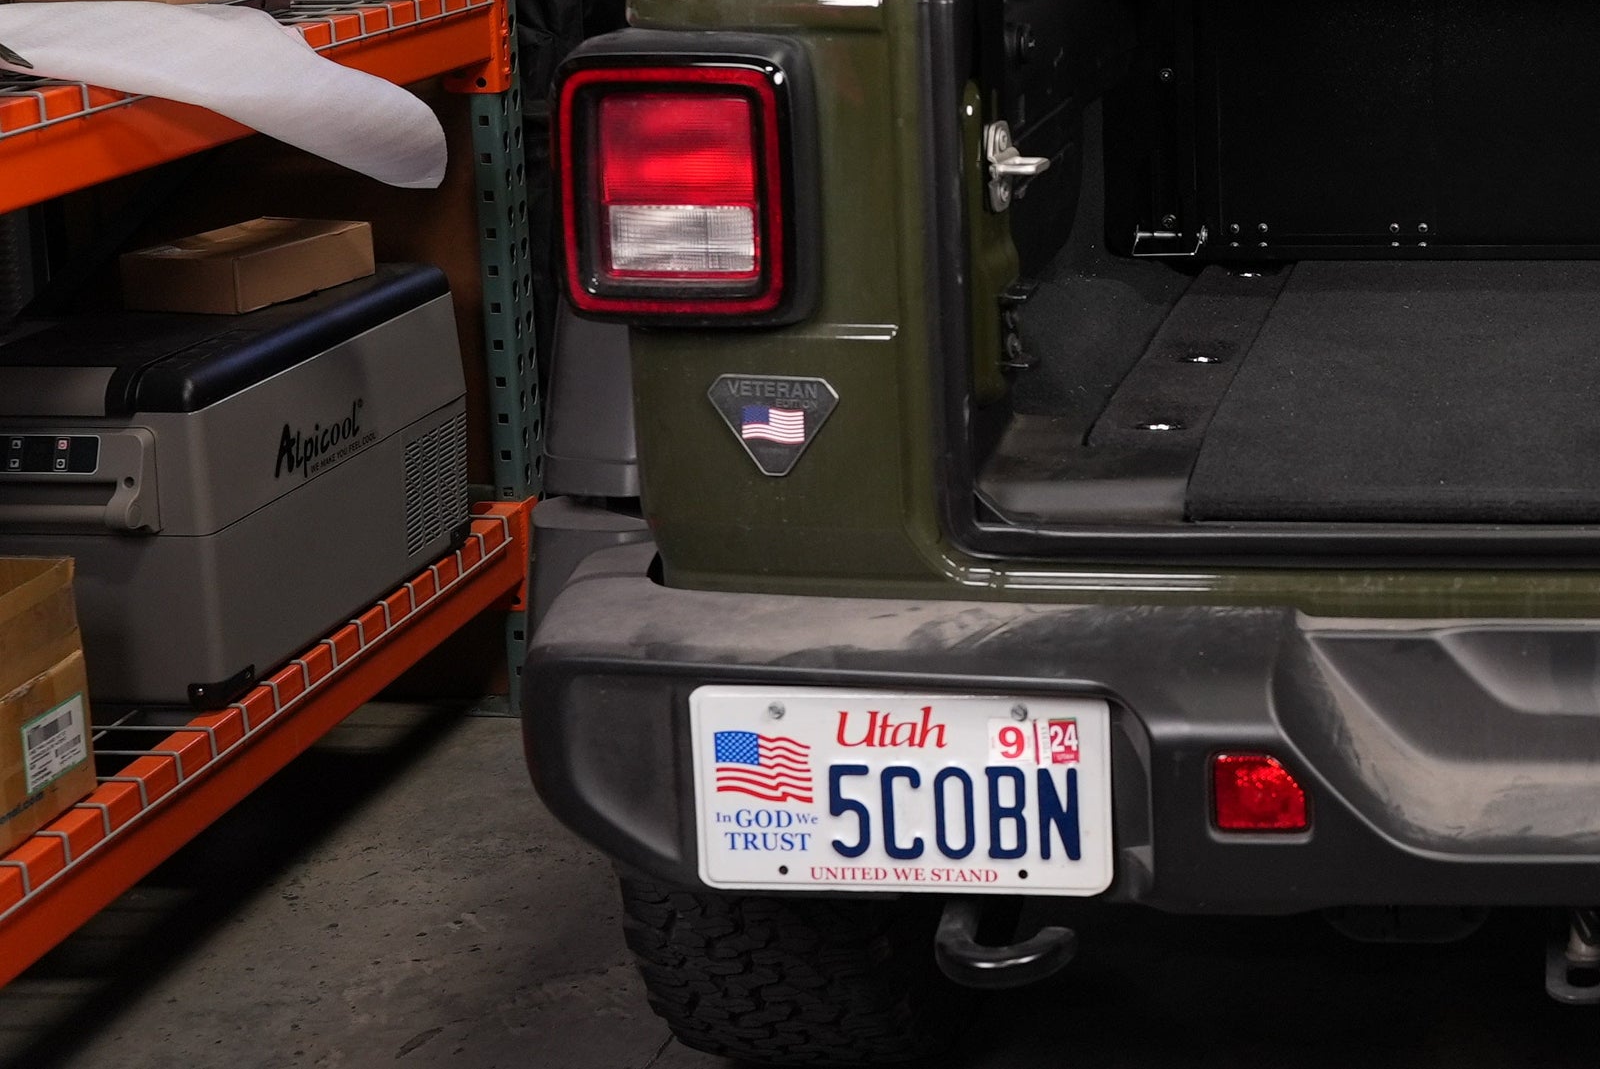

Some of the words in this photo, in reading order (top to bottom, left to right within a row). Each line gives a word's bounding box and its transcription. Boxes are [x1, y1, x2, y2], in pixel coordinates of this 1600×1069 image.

[727, 380, 818, 399] VETERAN
[775, 398, 818, 409] EDITION
[275, 400, 360, 479] Alpicool
[837, 706, 947, 748] Utah
[999, 726, 1025, 759] 9
[1050, 724, 1079, 753] 24
[716, 811, 731, 823] In
[735, 809, 792, 829] GOD
[796, 812, 818, 825] We
[725, 832, 811, 852] TRUST
[810, 867, 888, 881] UNITED
[893, 867, 926, 881] WE
[930, 868, 998, 883] STAND
